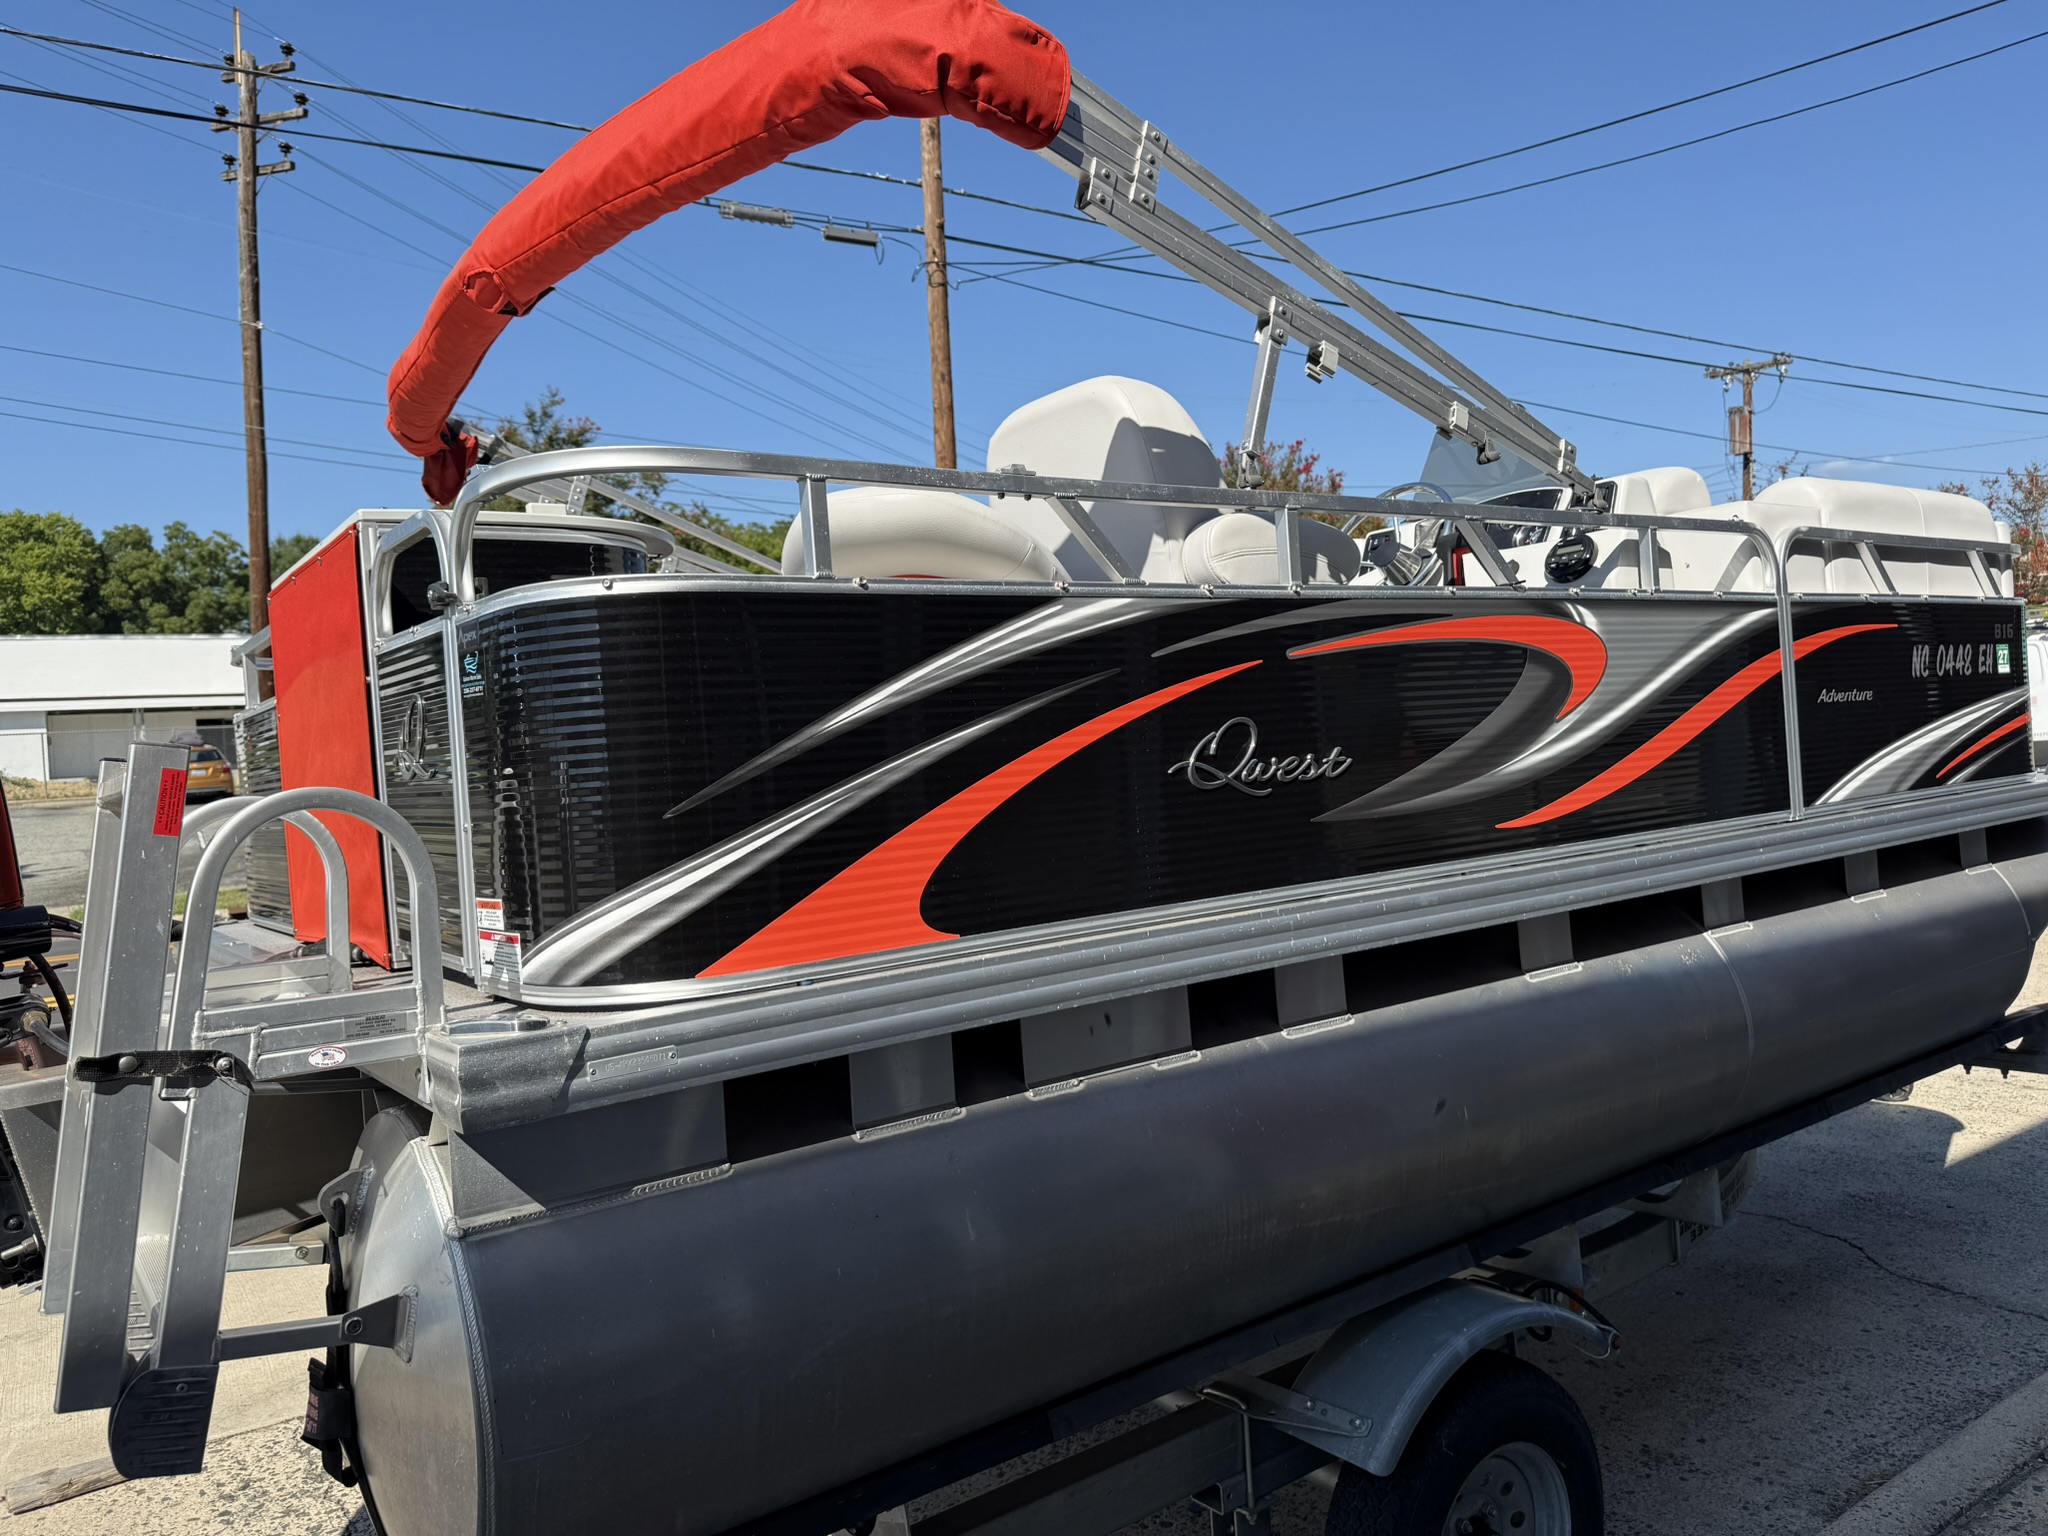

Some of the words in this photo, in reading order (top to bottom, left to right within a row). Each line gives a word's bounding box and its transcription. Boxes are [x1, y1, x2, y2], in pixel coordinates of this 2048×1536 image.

[1912, 644, 1929, 678] NC
[1936, 643, 1972, 676] 0448
[1978, 643, 1993, 674] EH
[1997, 650, 2008, 664] 27
[1817, 688, 1873, 703] Adventure
[1168, 717, 1353, 796] Qwest
